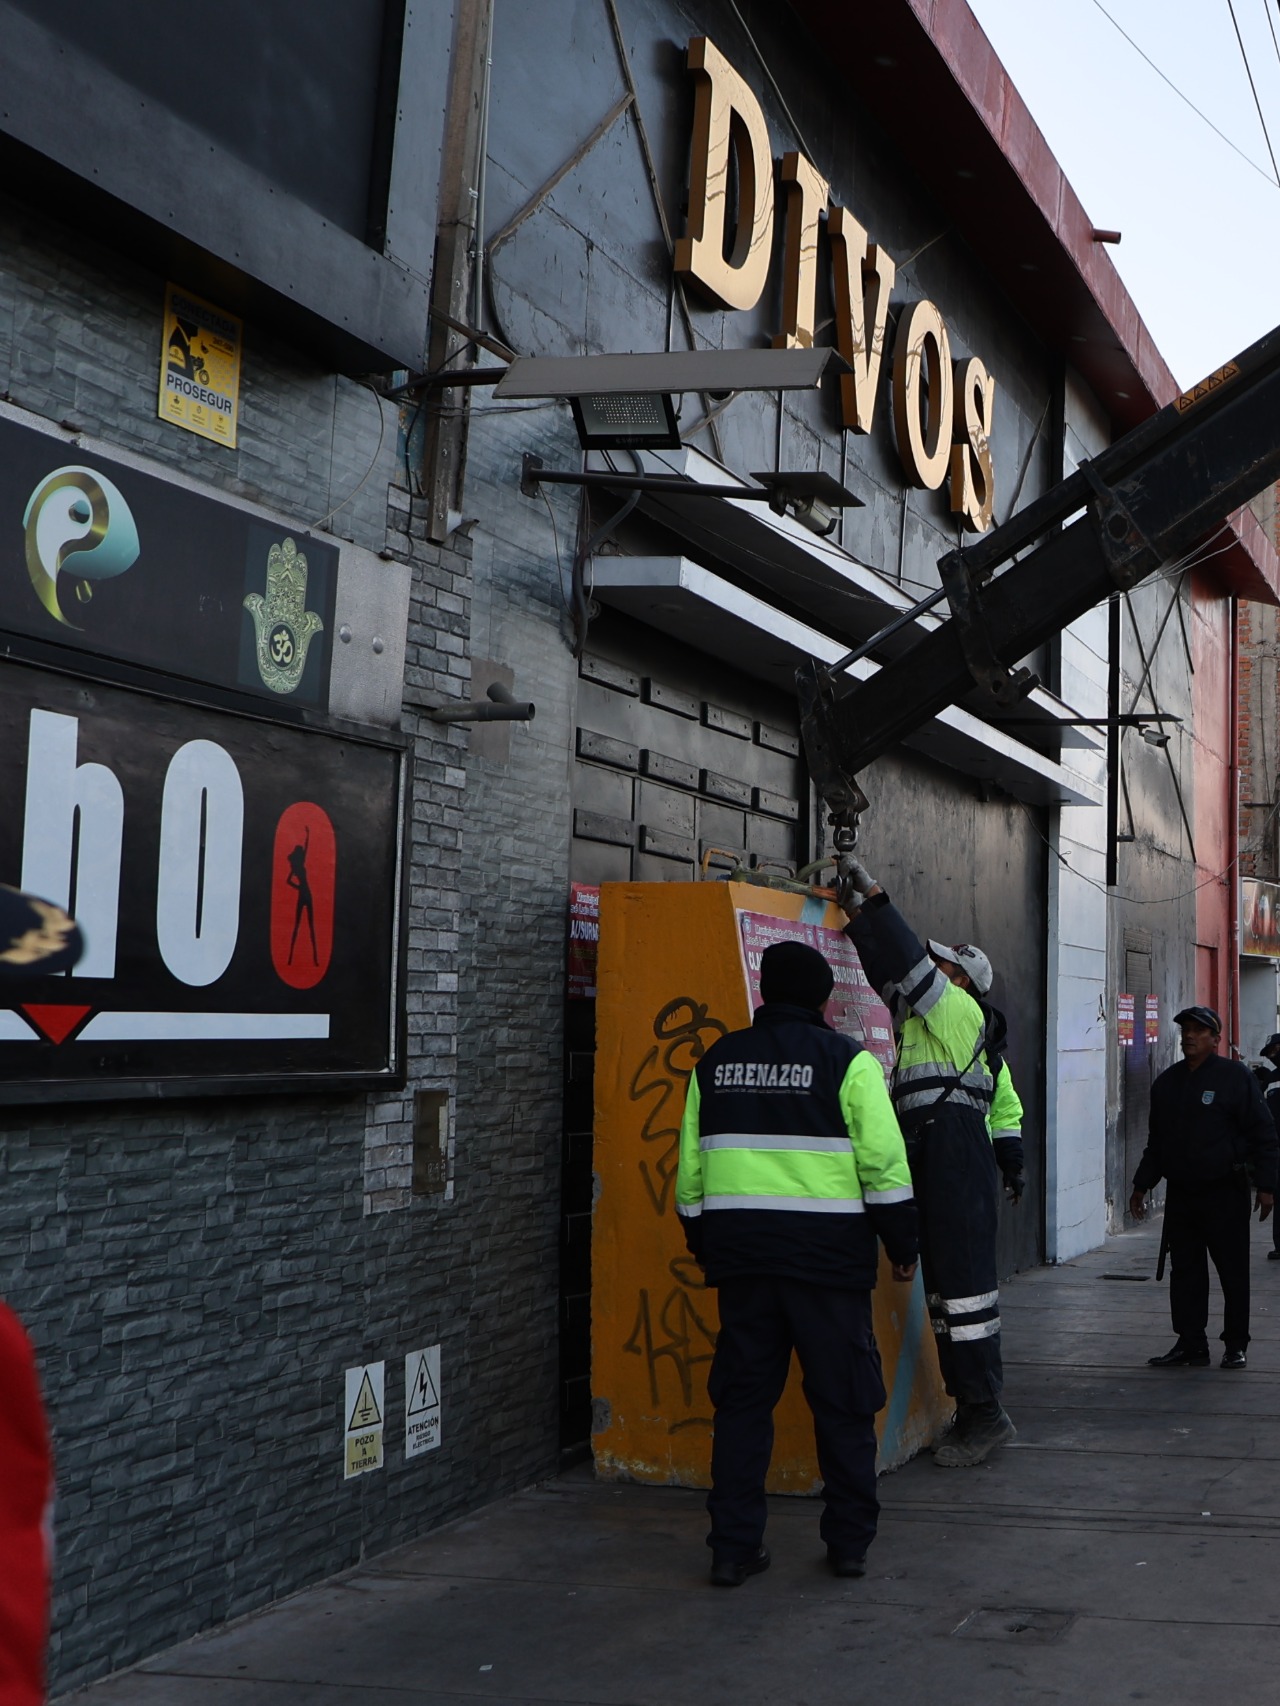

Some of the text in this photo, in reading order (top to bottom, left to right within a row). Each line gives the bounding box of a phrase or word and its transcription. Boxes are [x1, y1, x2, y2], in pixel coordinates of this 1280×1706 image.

[674, 36, 994, 534] DIVOS
[167, 373, 233, 415] PROSEGUR
[714, 1062, 813, 1088] SERENAZGO
[354, 1435, 375, 1447] POZO
[361, 1447, 367, 1457] A
[351, 1456, 377, 1470] TIERRA
